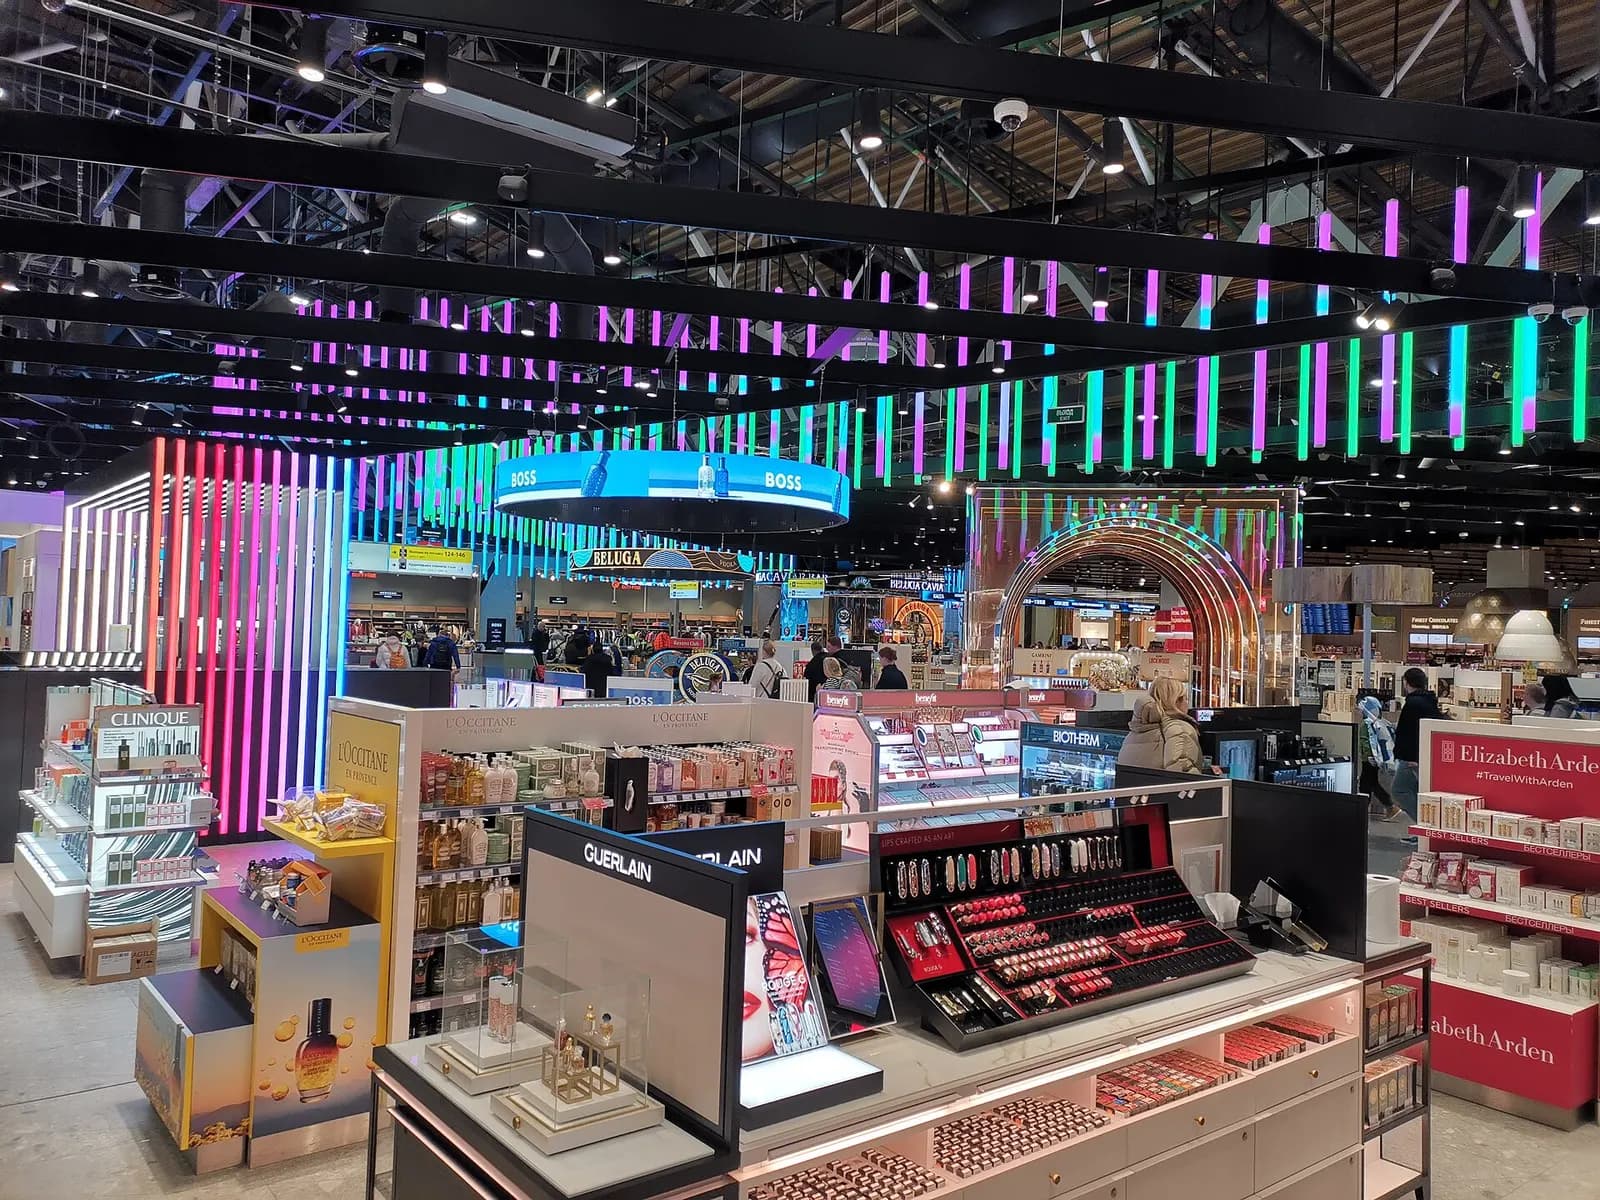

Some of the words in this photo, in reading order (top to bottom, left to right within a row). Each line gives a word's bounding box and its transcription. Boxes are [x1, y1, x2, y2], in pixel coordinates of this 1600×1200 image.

[511, 470, 537, 488] BOSS
[764, 472, 802, 491] BOSS
[593, 550, 642, 566] BELUGA
[921, 581, 944, 592] CAVIA
[689, 656, 721, 672] BELUGA
[826, 695, 849, 707] benefit
[915, 693, 937, 704] benefit
[111, 711, 190, 727] CLINIQUE
[1053, 730, 1100, 748] BIOTHERM
[1461, 744, 1547, 769] Elizabeth
[1549, 754, 1600, 774] Arde
[1476, 771, 1574, 789] #TravelWithArden
[923, 834, 932, 842] AS
[1425, 829, 1448, 840] BEST
[1449, 832, 1489, 846] SELLERS
[1523, 844, 1592, 861] БЕСТСЕЛЛЕРЫ
[583, 842, 652, 882] GUERLAIN
[1405, 894, 1427, 906] BEST
[1429, 899, 1470, 914] SELLERS
[1505, 915, 1575, 934] БЕСТСЕЛЛЕРЫ
[132, 949, 155, 959] AGILE
[761, 975, 797, 992] ROUGE
[798, 974, 806, 984] G
[1431, 1016, 1485, 1046] abeth
[1486, 1030, 1555, 1065] Arden
